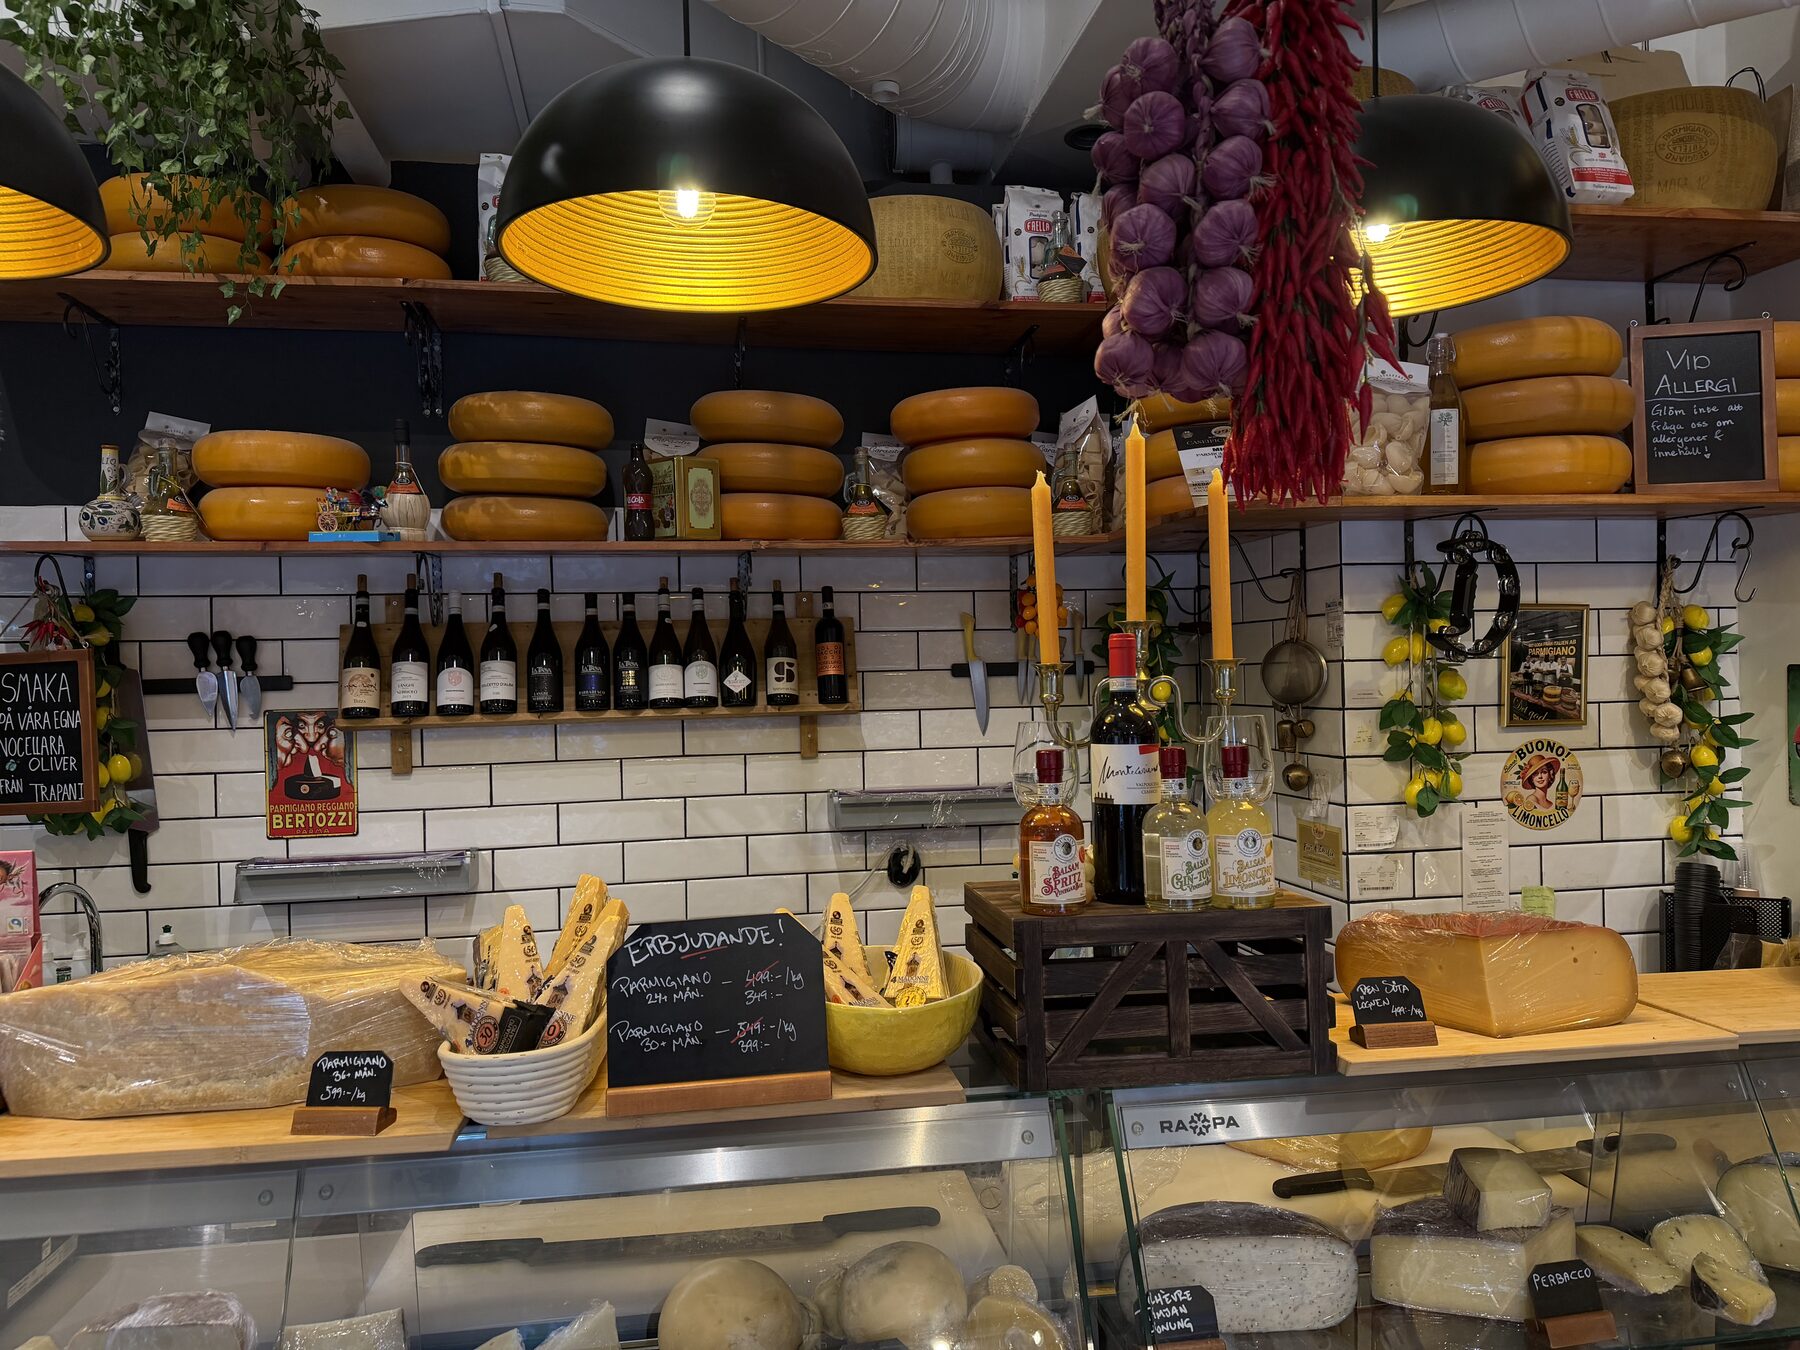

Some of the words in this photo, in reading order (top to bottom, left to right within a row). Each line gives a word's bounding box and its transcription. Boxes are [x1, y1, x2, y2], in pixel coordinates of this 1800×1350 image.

[1026, 220, 1050, 232] FAELLA
[1654, 374, 1737, 396] ALLERGI
[1651, 404, 1686, 417] Glöm
[1693, 404, 1719, 415] inte
[1727, 404, 1744, 412] att
[1651, 420, 1684, 435] fråga
[1690, 421, 1709, 429] oss
[1716, 418, 1735, 427] om
[1652, 434, 1708, 448] allergener
[1528, 645, 1577, 656] PARMIGIANO
[1, 672, 72, 703] SMAKA
[17, 705, 52, 731] VÅRA
[54, 710, 82, 730] EGNA
[1515, 740, 1572, 762] BUONO!
[28, 756, 78, 772] OLIVER
[0, 774, 23, 794] FRÅN
[29, 782, 85, 802] TRAPANI
[270, 803, 316, 814] PARMIGIANO
[317, 801, 355, 812] REGGIANO
[1511, 805, 1570, 828] LIMONCELLO
[272, 811, 353, 829] BERTOZZI
[1052, 861, 1080, 879] BALSAM
[1041, 871, 1082, 896] SPRITZ
[612, 971, 712, 998] PARMIGIANO
[1356, 984, 1380, 996] DEN
[673, 987, 704, 1004] MÅN.
[479, 1025, 494, 1045] 30
[609, 1020, 703, 1043] PARMIGIANO
[640, 1037, 667, 1053] 30+
[672, 1033, 704, 1052] MÅN.
[317, 1054, 387, 1073] PARMIGIANO
[332, 1070, 351, 1082] 36+
[354, 1067, 377, 1079] MÅN.
[1532, 1267, 1592, 1292] PERBACCO
[1151, 1318, 1194, 1335] ONUNG
